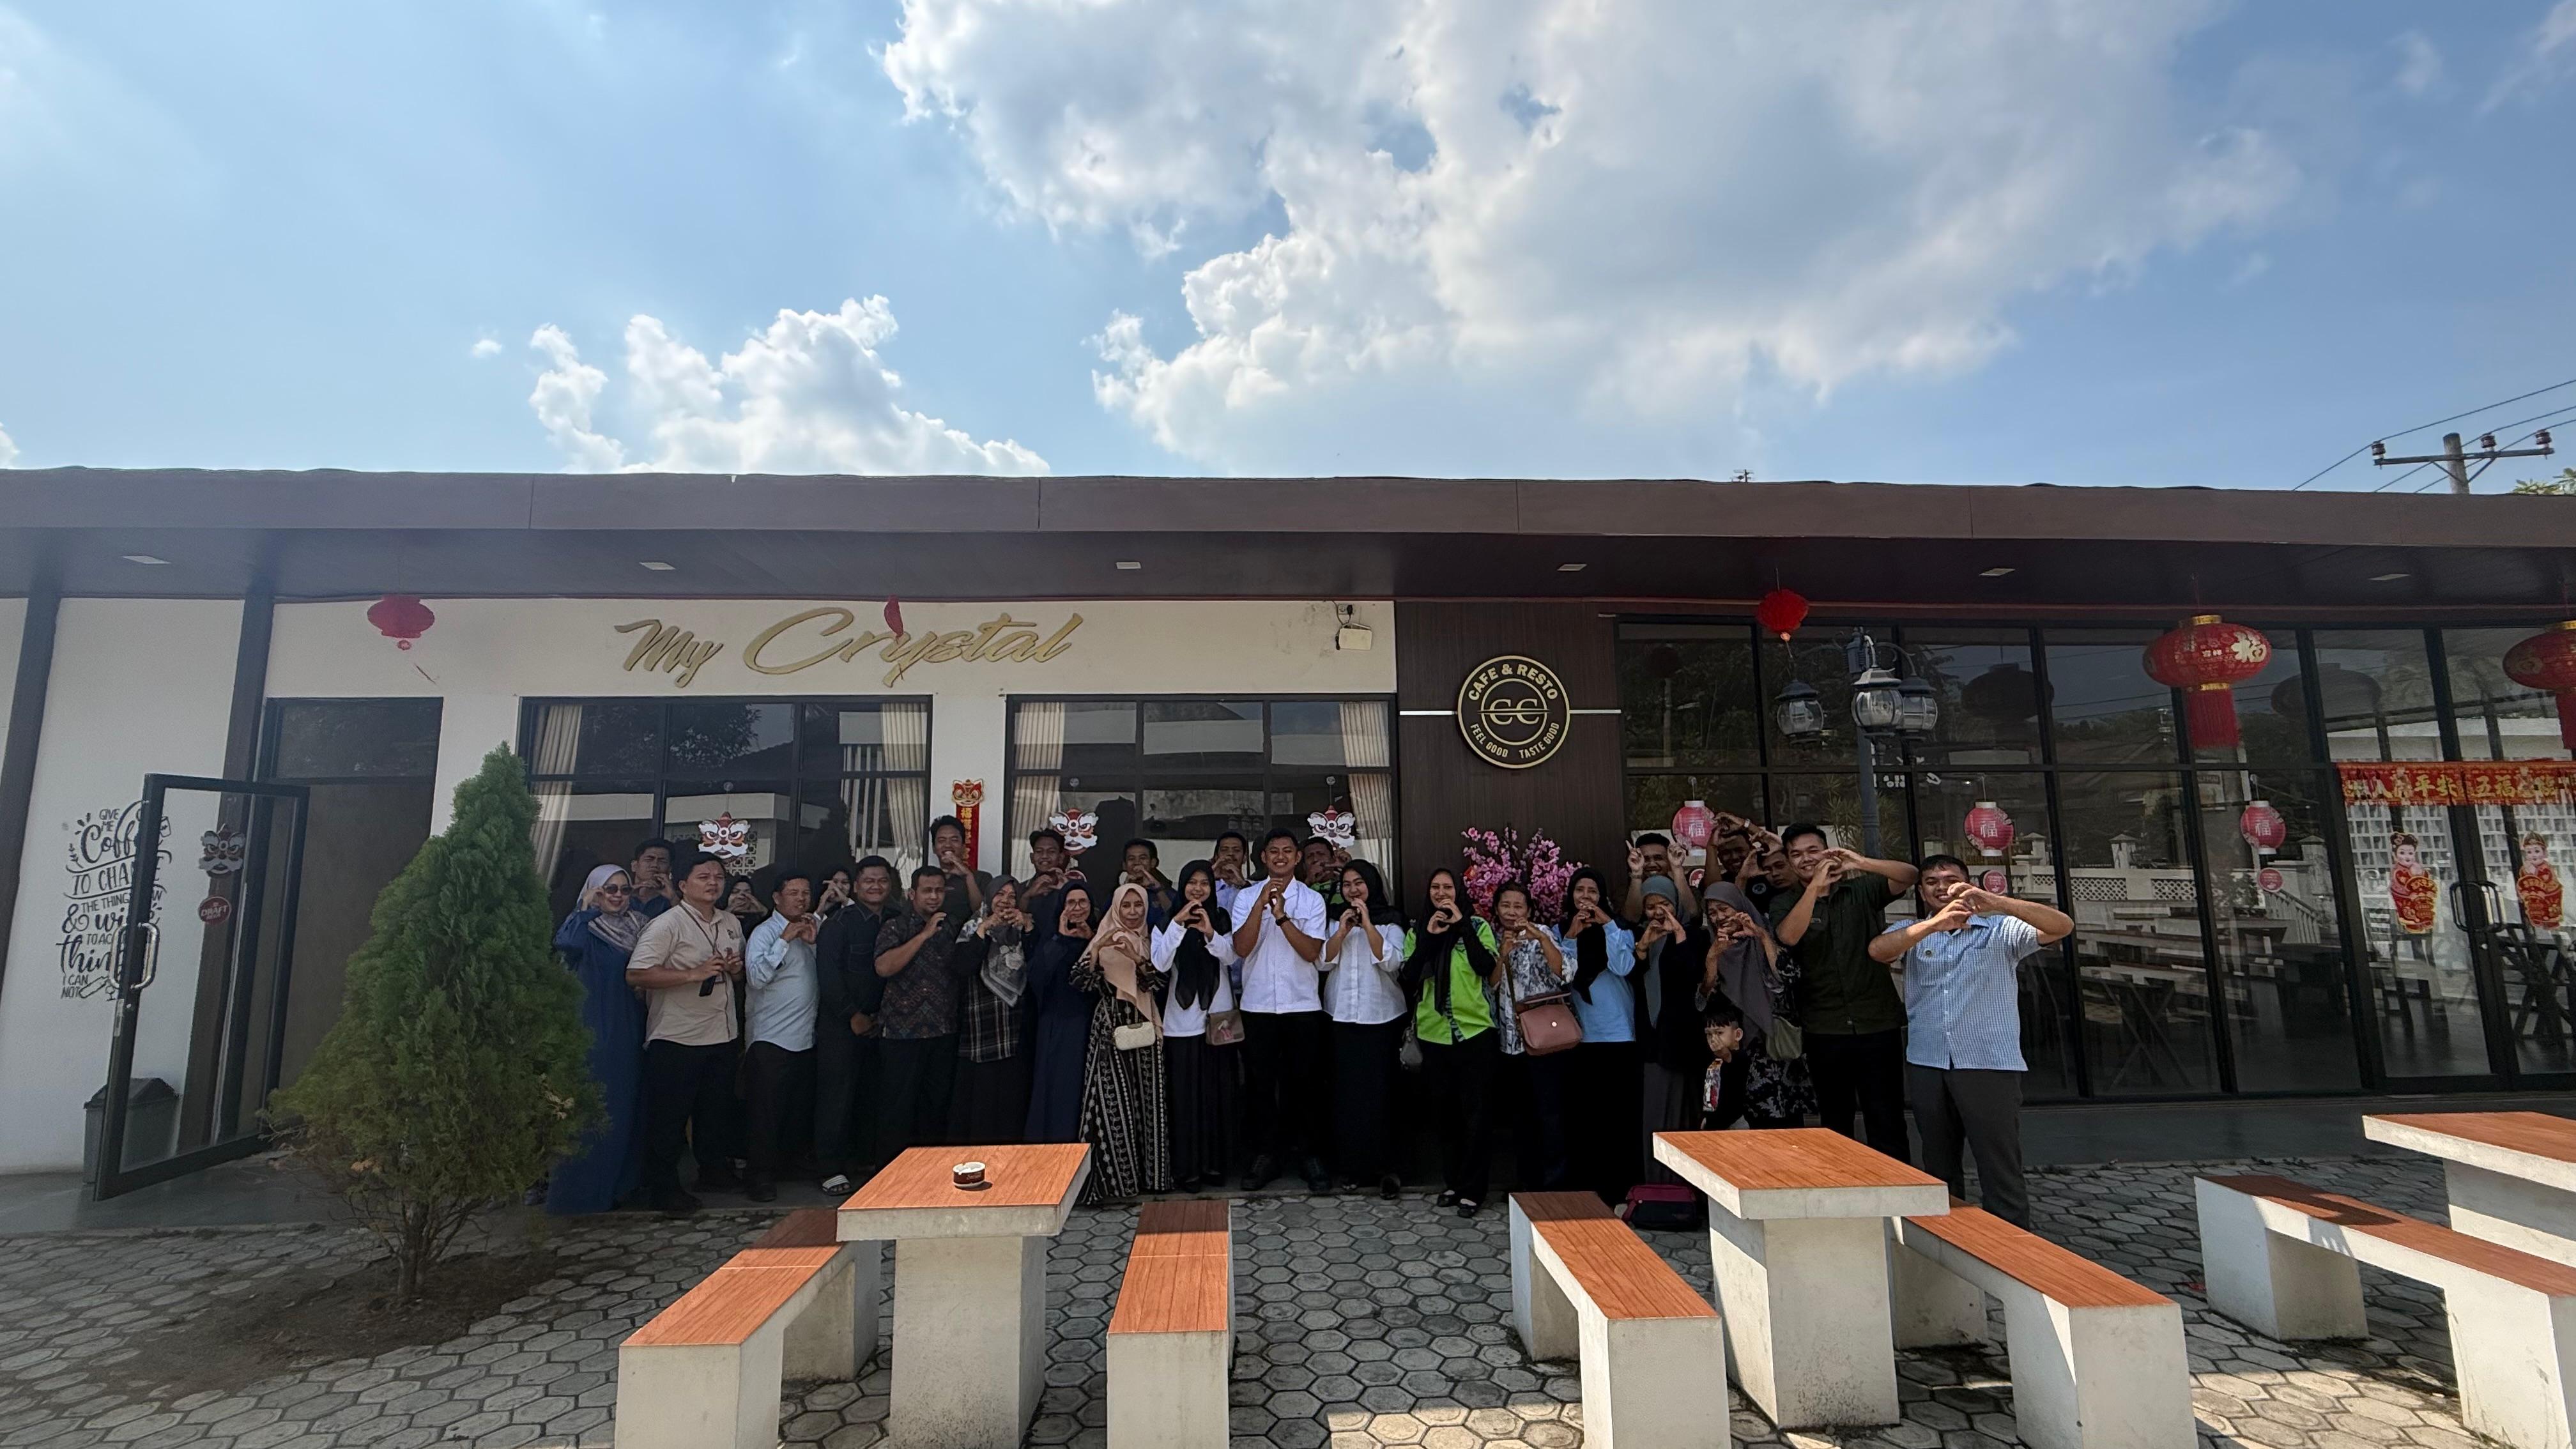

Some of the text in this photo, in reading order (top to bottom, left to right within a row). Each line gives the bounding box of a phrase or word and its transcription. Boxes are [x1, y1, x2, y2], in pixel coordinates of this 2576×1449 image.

[614, 607, 1084, 688] My Crystal
[1468, 664, 1558, 700] CAFE & RESTO
[1470, 723, 1508, 758] FEEL GOOD
[1519, 723, 1560, 759] TASTE GOOD
[99, 808, 120, 820] GIVE
[101, 820, 114, 832] ME
[1688, 820, 1705, 838] 福
[1981, 820, 1998, 838] 福
[2255, 819, 2271, 836] 福
[73, 873, 91, 896] TO
[80, 899, 100, 913] THE
[201, 905, 229, 916] DRAFT
[62, 903, 89, 933] &
[87, 933, 96, 945] TO
[68, 974, 89, 986] CAN
[61, 986, 80, 999] NOT
